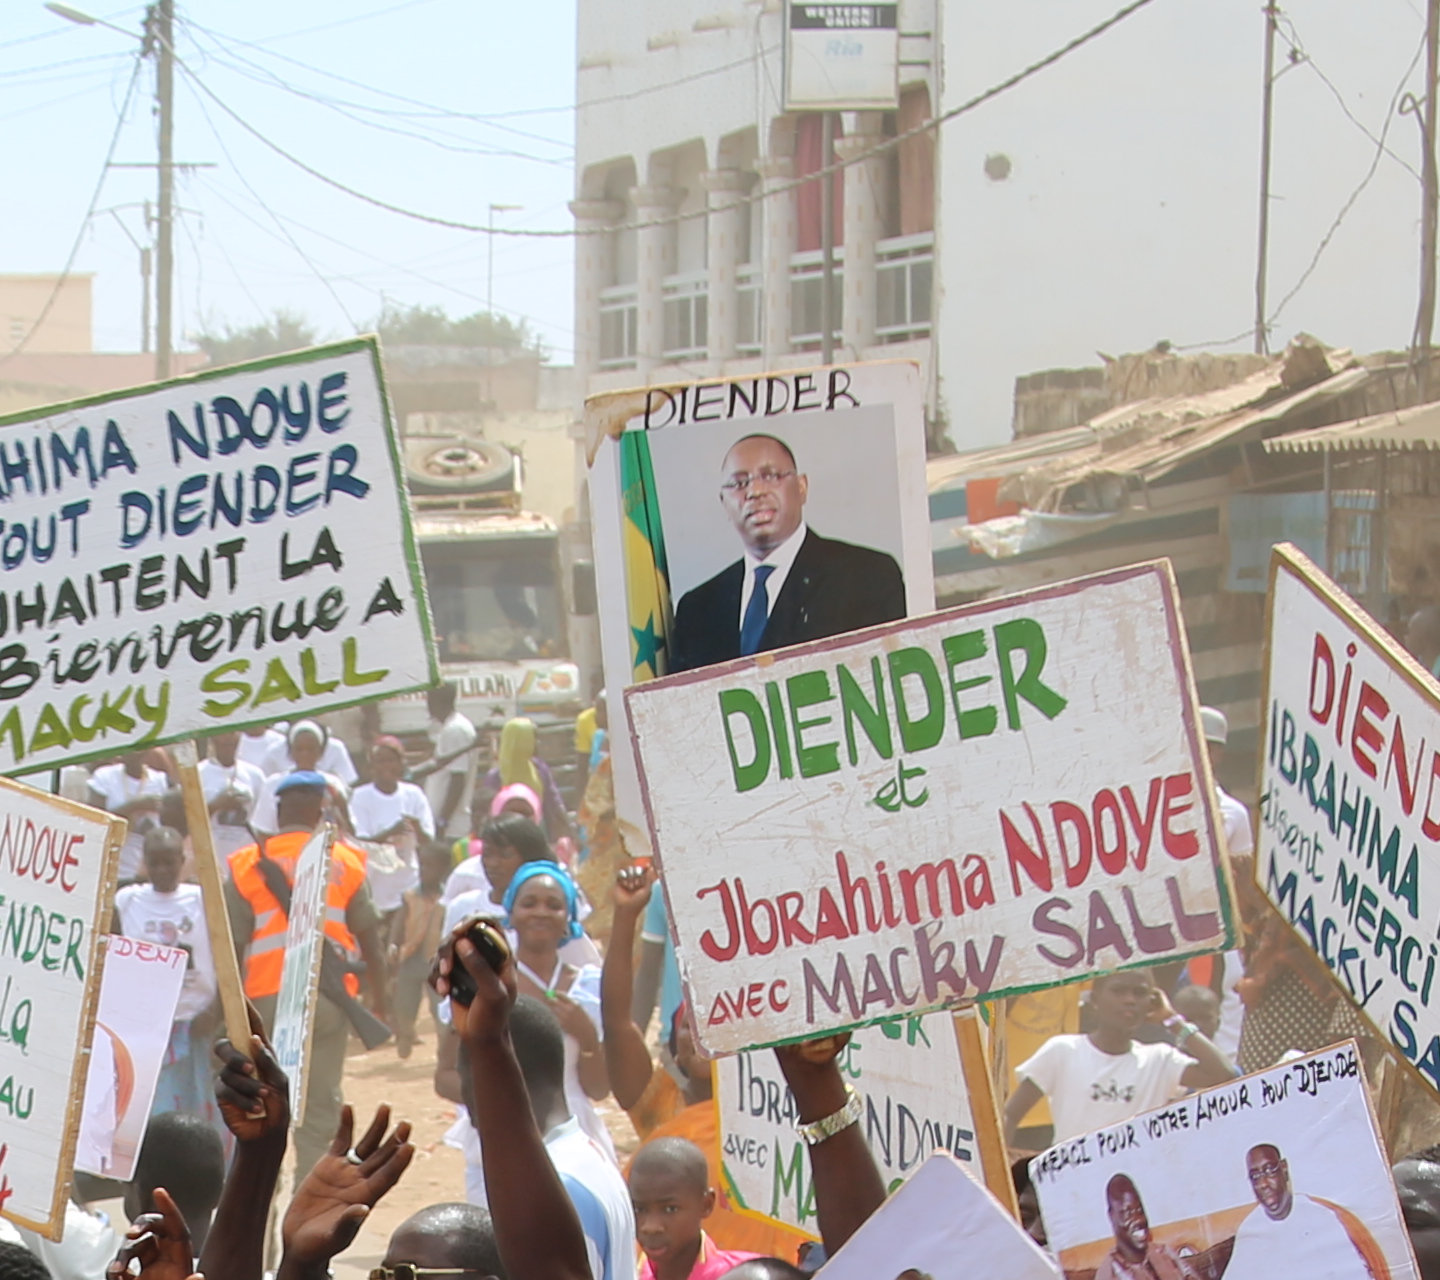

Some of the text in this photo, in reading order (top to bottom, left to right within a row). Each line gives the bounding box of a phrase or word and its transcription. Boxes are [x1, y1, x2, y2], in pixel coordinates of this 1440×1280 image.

[805, 6, 874, 18] WESTERN
[826, 18, 874, 28] UNION
[168, 371, 348, 467] NDOYE
[641, 369, 861, 433] DIENDER
[120, 444, 372, 548] DIENDER
[280, 526, 345, 581] LA
[363, 576, 406, 624] A
[201, 637, 391, 718] SALL
[718, 617, 1068, 793] DIENDER
[866, 759, 929, 813] et
[1270, 700, 1419, 919] IBRAHIMA
[1000, 773, 1201, 898] NDOYE
[1260, 790, 1324, 882] disent
[708, 979, 791, 1027] AVEC
[1032, 875, 1221, 970] SALL
[724, 1133, 768, 1168] AVEC
[1097, 1124, 1140, 1158] POUR
[1143, 1105, 1191, 1140] VOTRE
[1195, 1084, 1253, 1131] AMOUR
